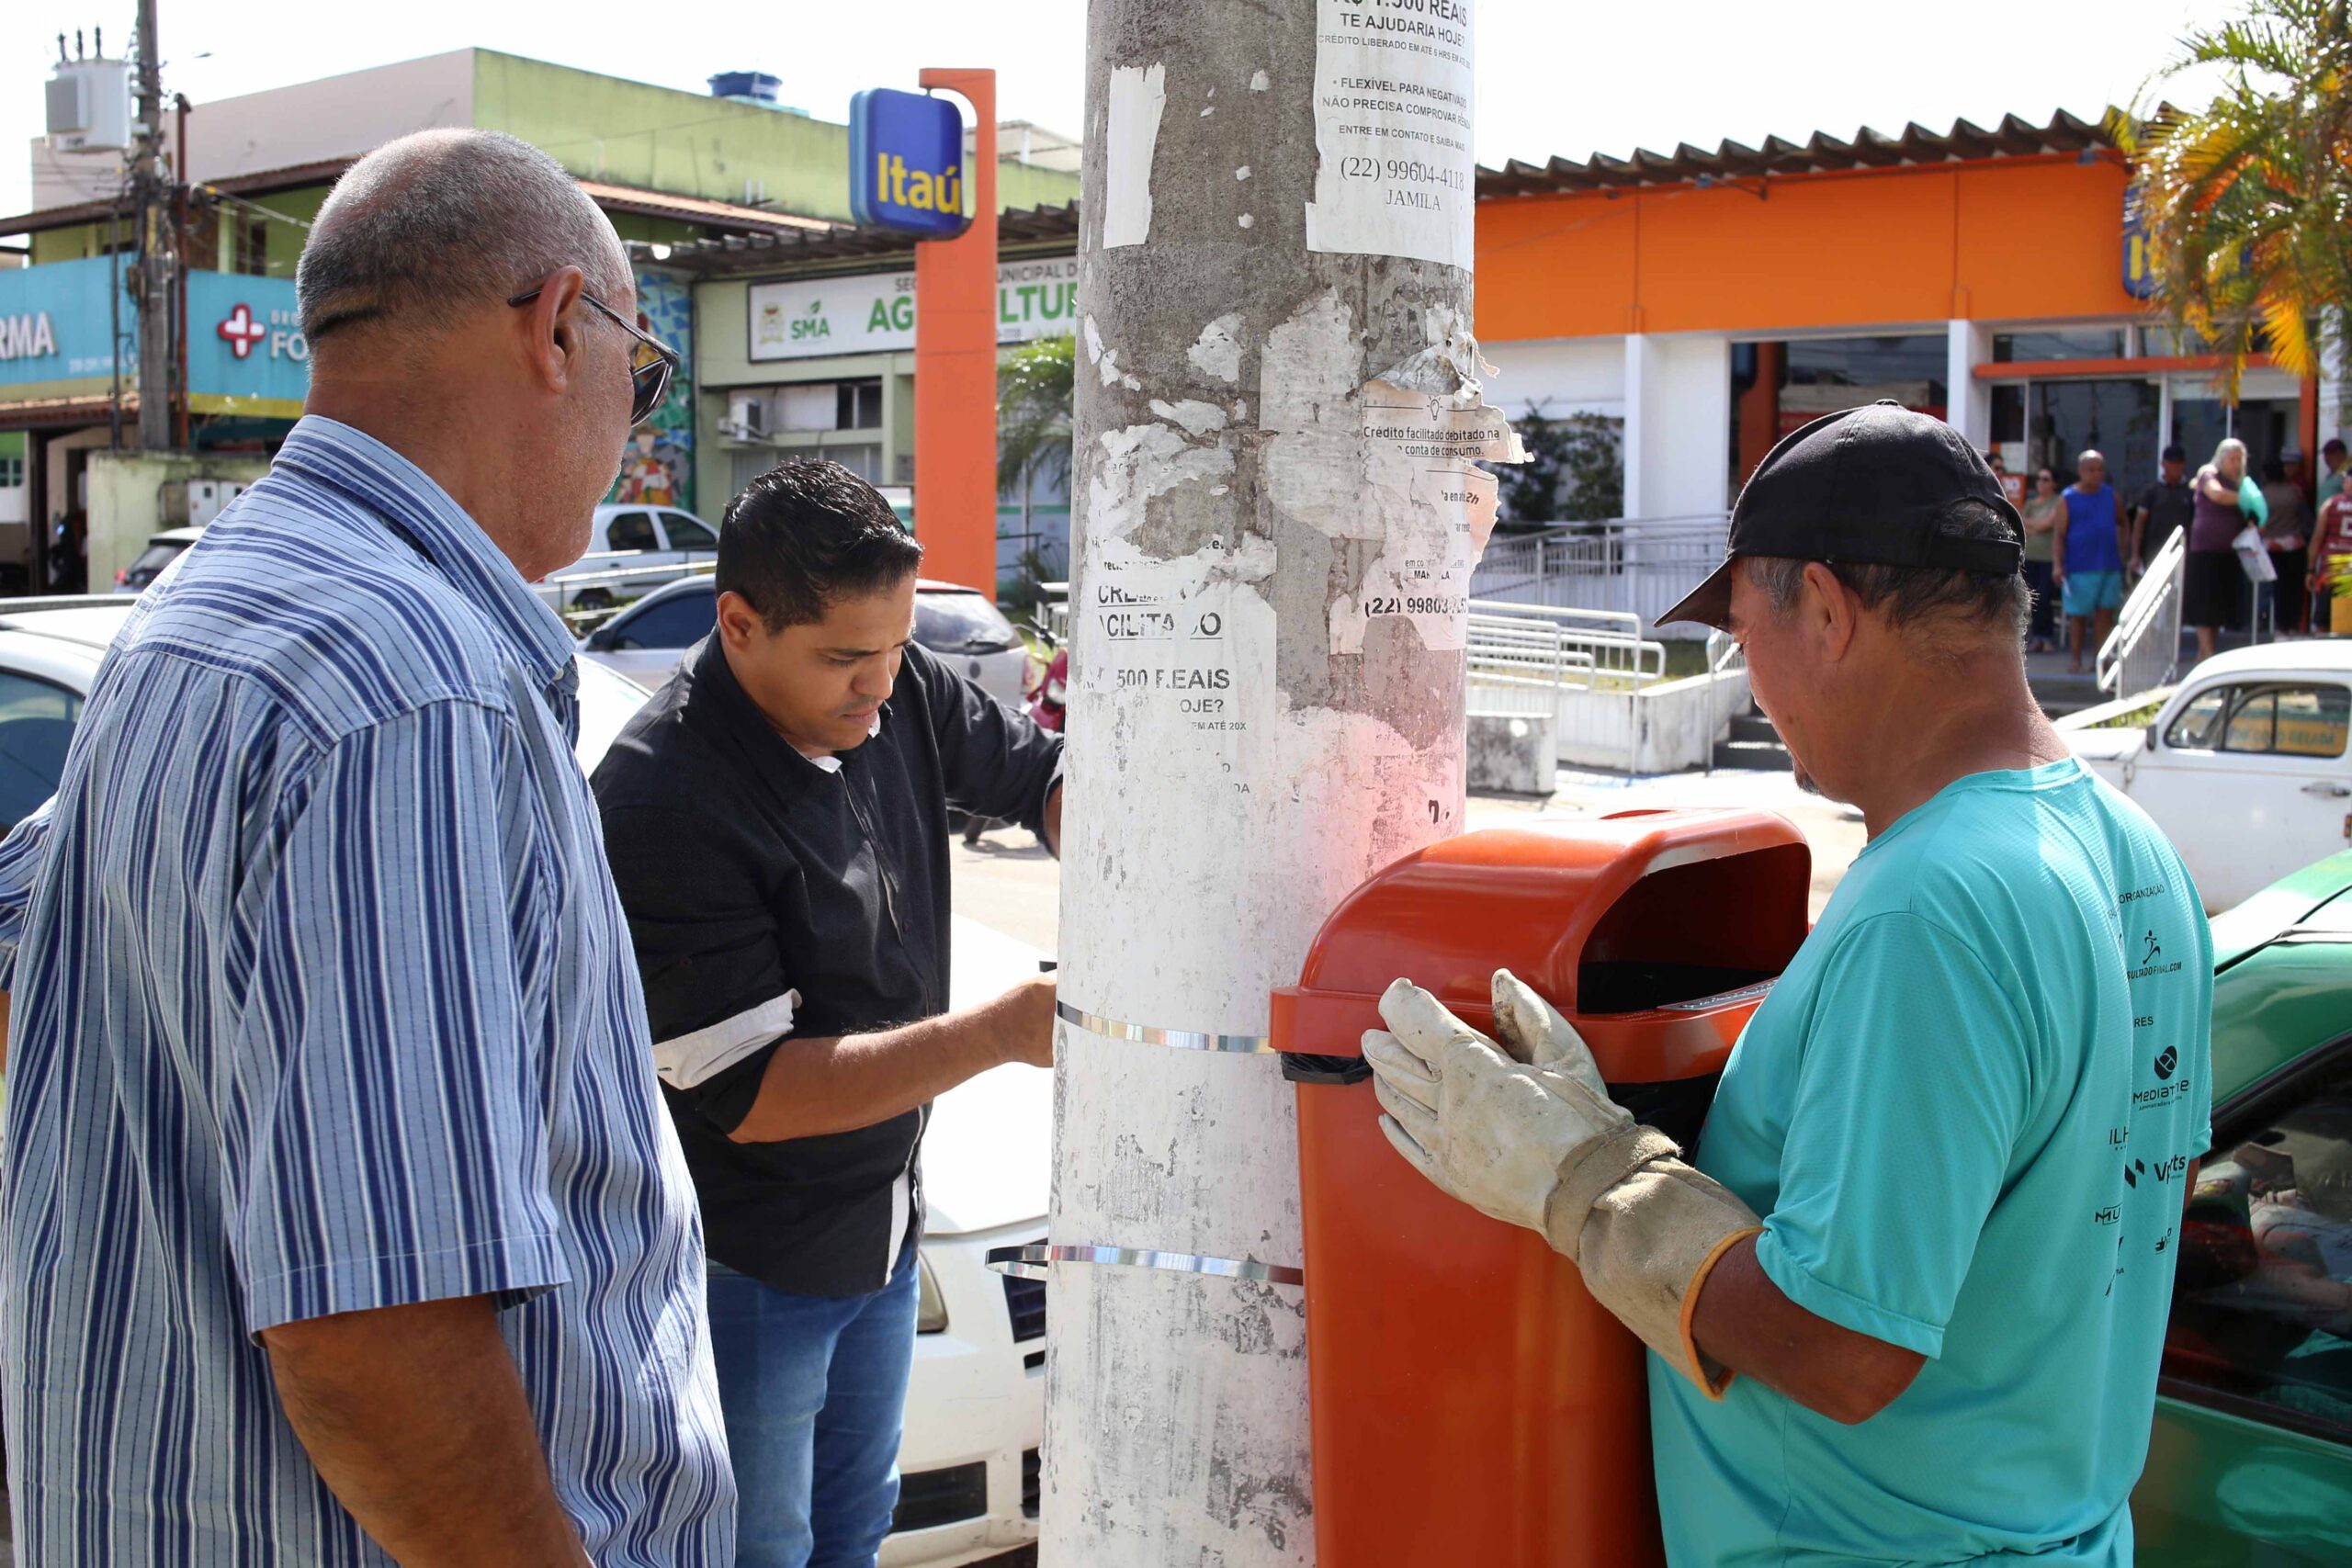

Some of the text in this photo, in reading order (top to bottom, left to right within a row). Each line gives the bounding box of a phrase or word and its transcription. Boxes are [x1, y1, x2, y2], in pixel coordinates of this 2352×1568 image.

[1430, 0, 1467, 27] REAIS
[1340, 13, 1465, 48] TE AJUDARIA HOJE?
[1362, 37, 1408, 51] LIBERADO
[1408, 43, 1419, 52] EM
[1340, 76, 1467, 109] FLEXÍVEL PARA NEGATIVADO
[1322, 96, 1350, 108] NÃO
[1353, 98, 1404, 113] PRECISA
[1406, 105, 1457, 123] COMPROVAR
[1339, 125, 1373, 136] ENTRE
[1374, 127, 1389, 137] EM
[1391, 129, 1429, 142] CONTATO
[1430, 135, 1435, 144] E
[1436, 136, 1454, 150] SAIBA
[877, 152, 961, 214] Itaú
[1340, 156, 1464, 192] (22) 99604-4118
[1385, 189, 1441, 211] JAMILA
[791, 317, 831, 339] SMA
[1363, 426, 1500, 442] Crédito facilitado debitado na
[1405, 445, 1484, 457] conta de consumo.
[1465, 491, 1479, 505] 2h
[1208, 719, 1227, 730] ATÉ
[1228, 721, 1247, 730] 20X
